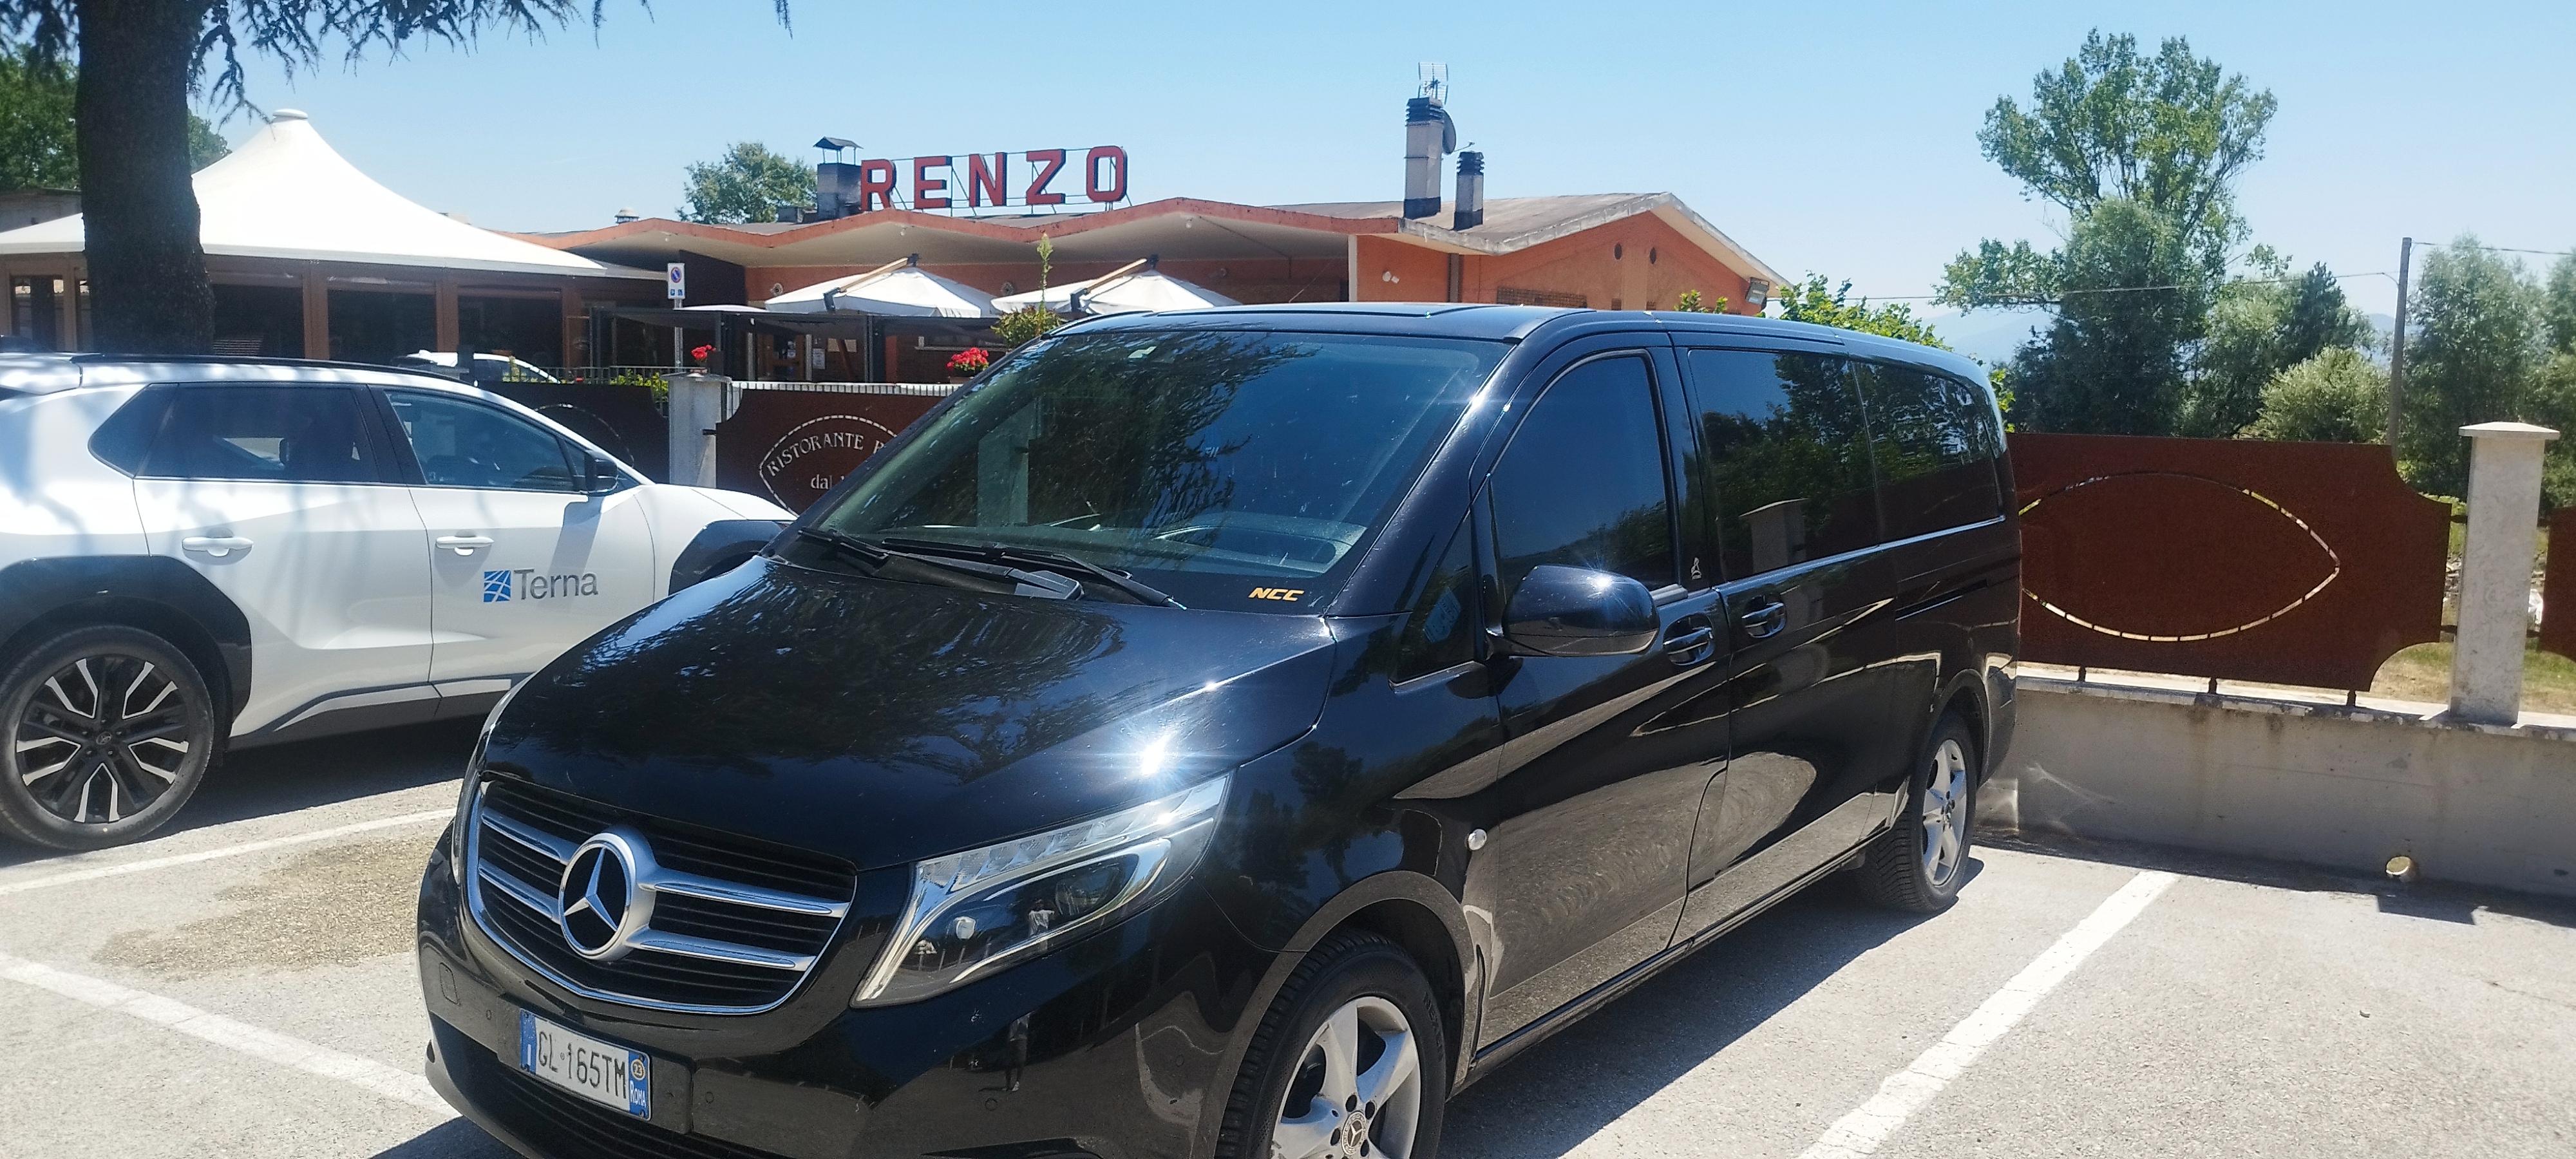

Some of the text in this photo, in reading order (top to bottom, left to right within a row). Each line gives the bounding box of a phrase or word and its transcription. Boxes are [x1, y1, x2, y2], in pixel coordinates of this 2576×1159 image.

[860, 146, 1128, 211] RENZO
[766, 432, 864, 476] RISTORANTE
[811, 474, 833, 489] dal
[513, 568, 599, 600] Terna
[1248, 587, 1305, 602] NCC
